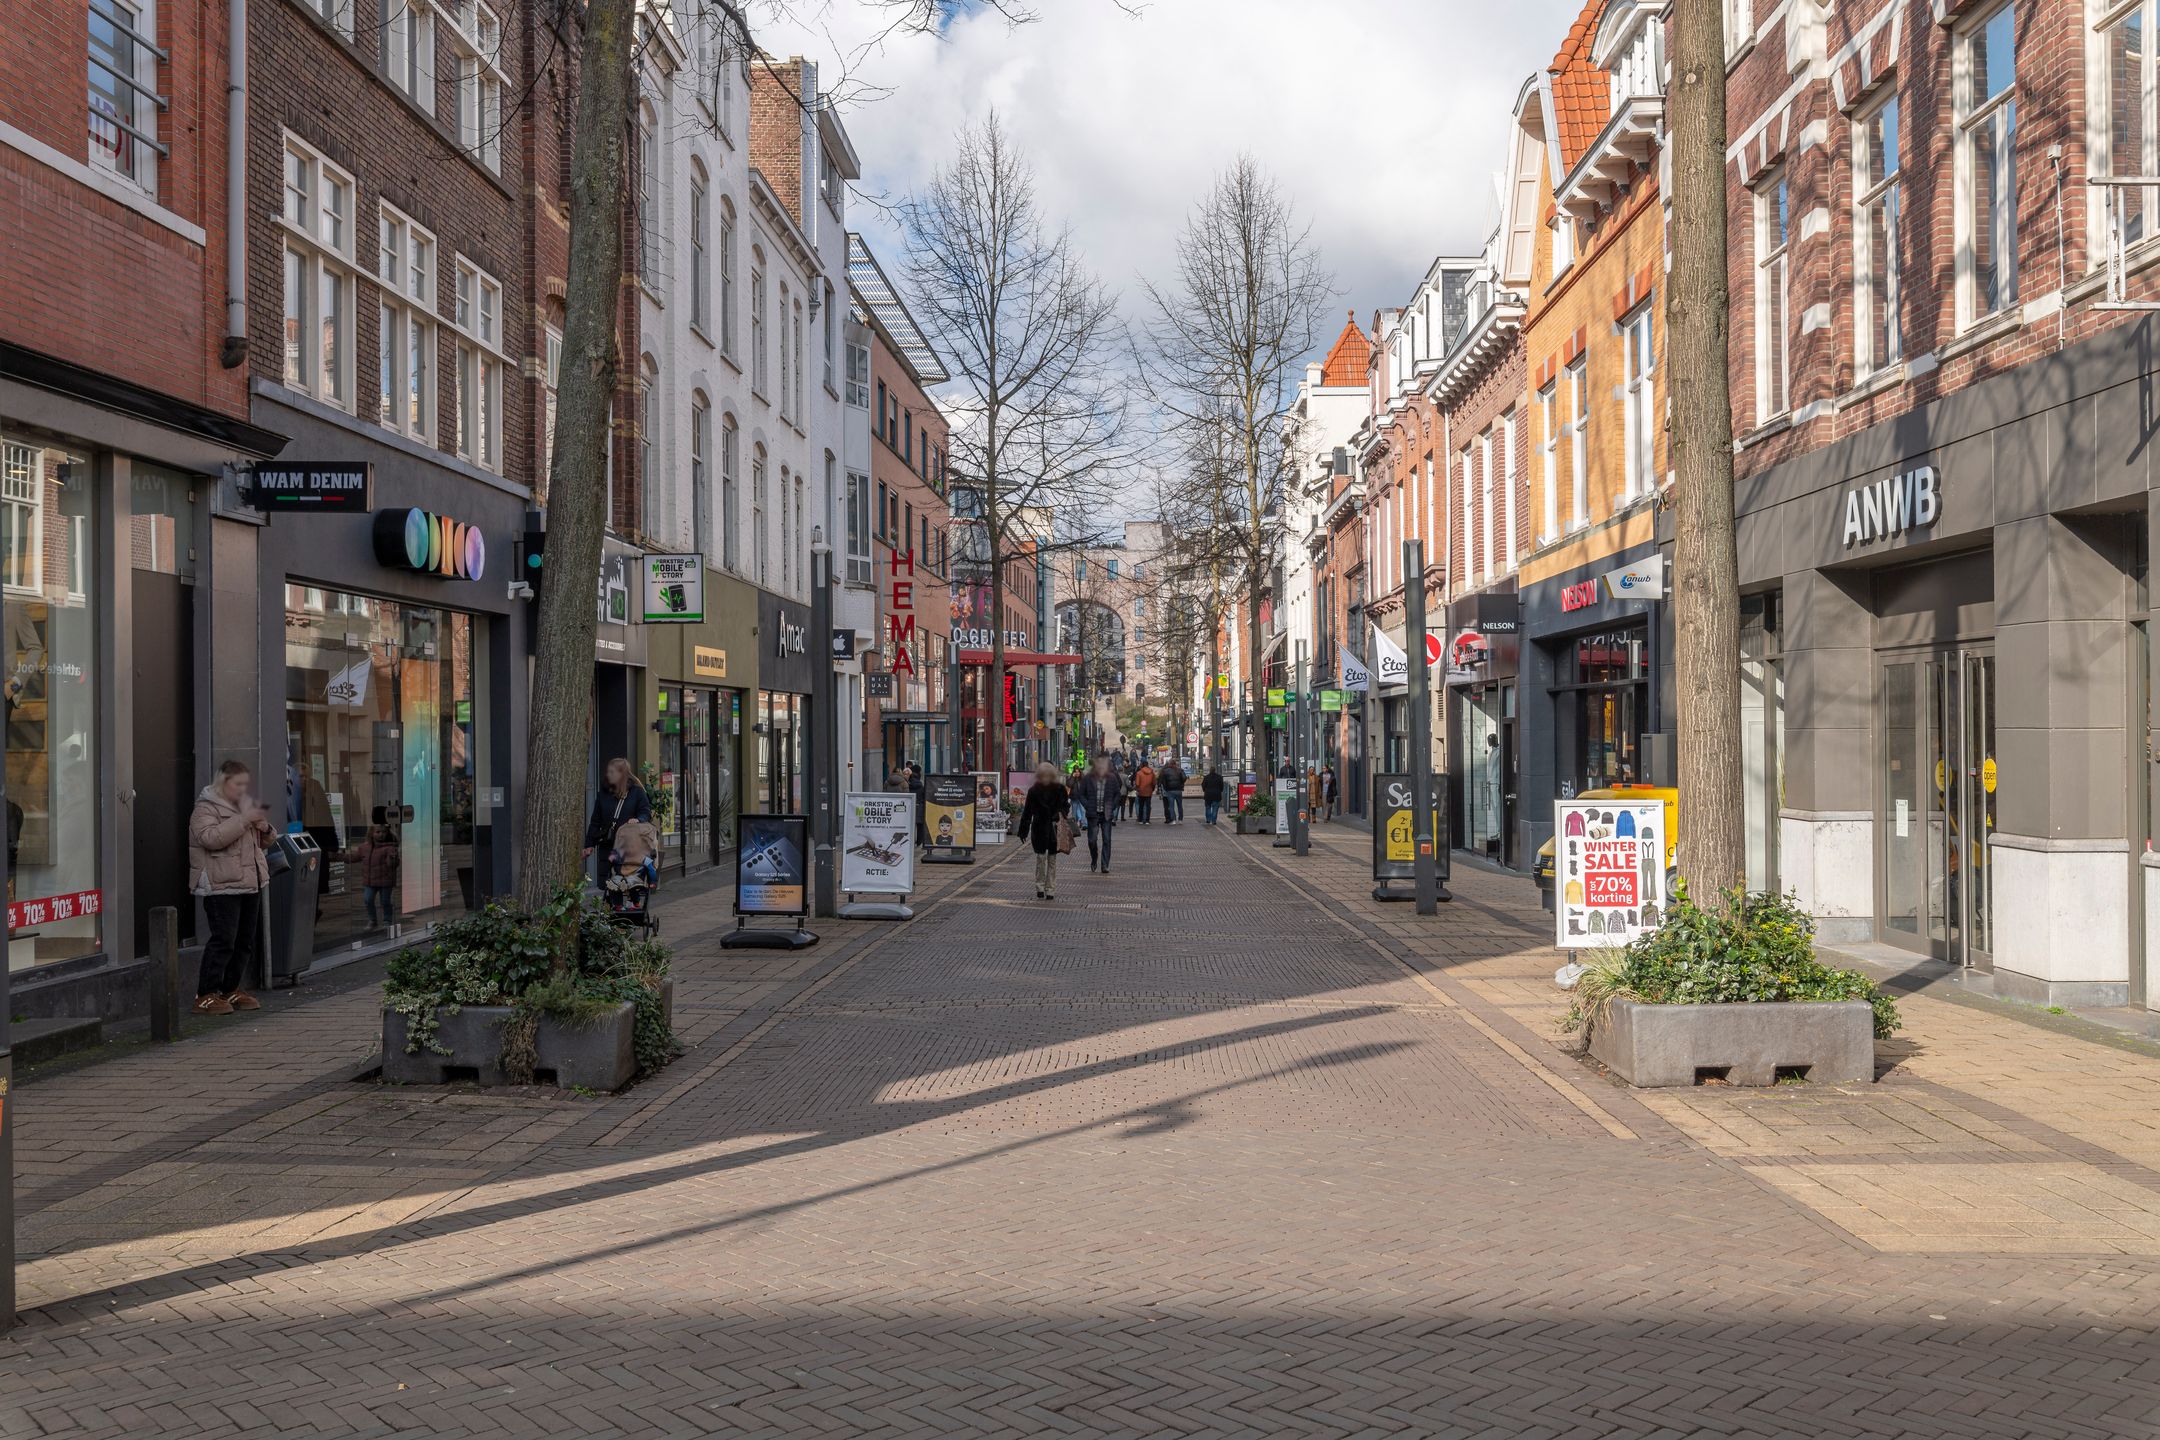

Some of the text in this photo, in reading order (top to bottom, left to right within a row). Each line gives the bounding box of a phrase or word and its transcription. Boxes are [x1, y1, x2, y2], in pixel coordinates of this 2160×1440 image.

[259, 472, 363, 489] WAM DENIM
[1843, 466, 1938, 545] ANWB
[652, 564, 684, 572] MOBILE
[1626, 575, 1651, 583] anwb
[1561, 578, 1597, 613] NELSON
[891, 549, 915, 675] HEMA
[779, 610, 805, 658] Amac
[1482, 622, 1515, 630] NELSON
[1382, 656, 1408, 672] Etos
[1345, 668, 1368, 682] Etos
[1984, 771, 1996, 782] open
[1387, 782, 1437, 807] Sae
[855, 807, 892, 816] MOBILE
[859, 816, 892, 824] FCTORY
[1390, 828, 1414, 843] €1
[1584, 842, 1637, 852] WINTER
[1584, 853, 1637, 870] SALE
[865, 868, 889, 876] ACTIE:
[1595, 876, 1633, 892] 70%
[79, 894, 99, 915] 70%
[1590, 892, 1633, 904] korting
[24, 903, 45, 926] 70%
[52, 898, 72, 920] 70%
